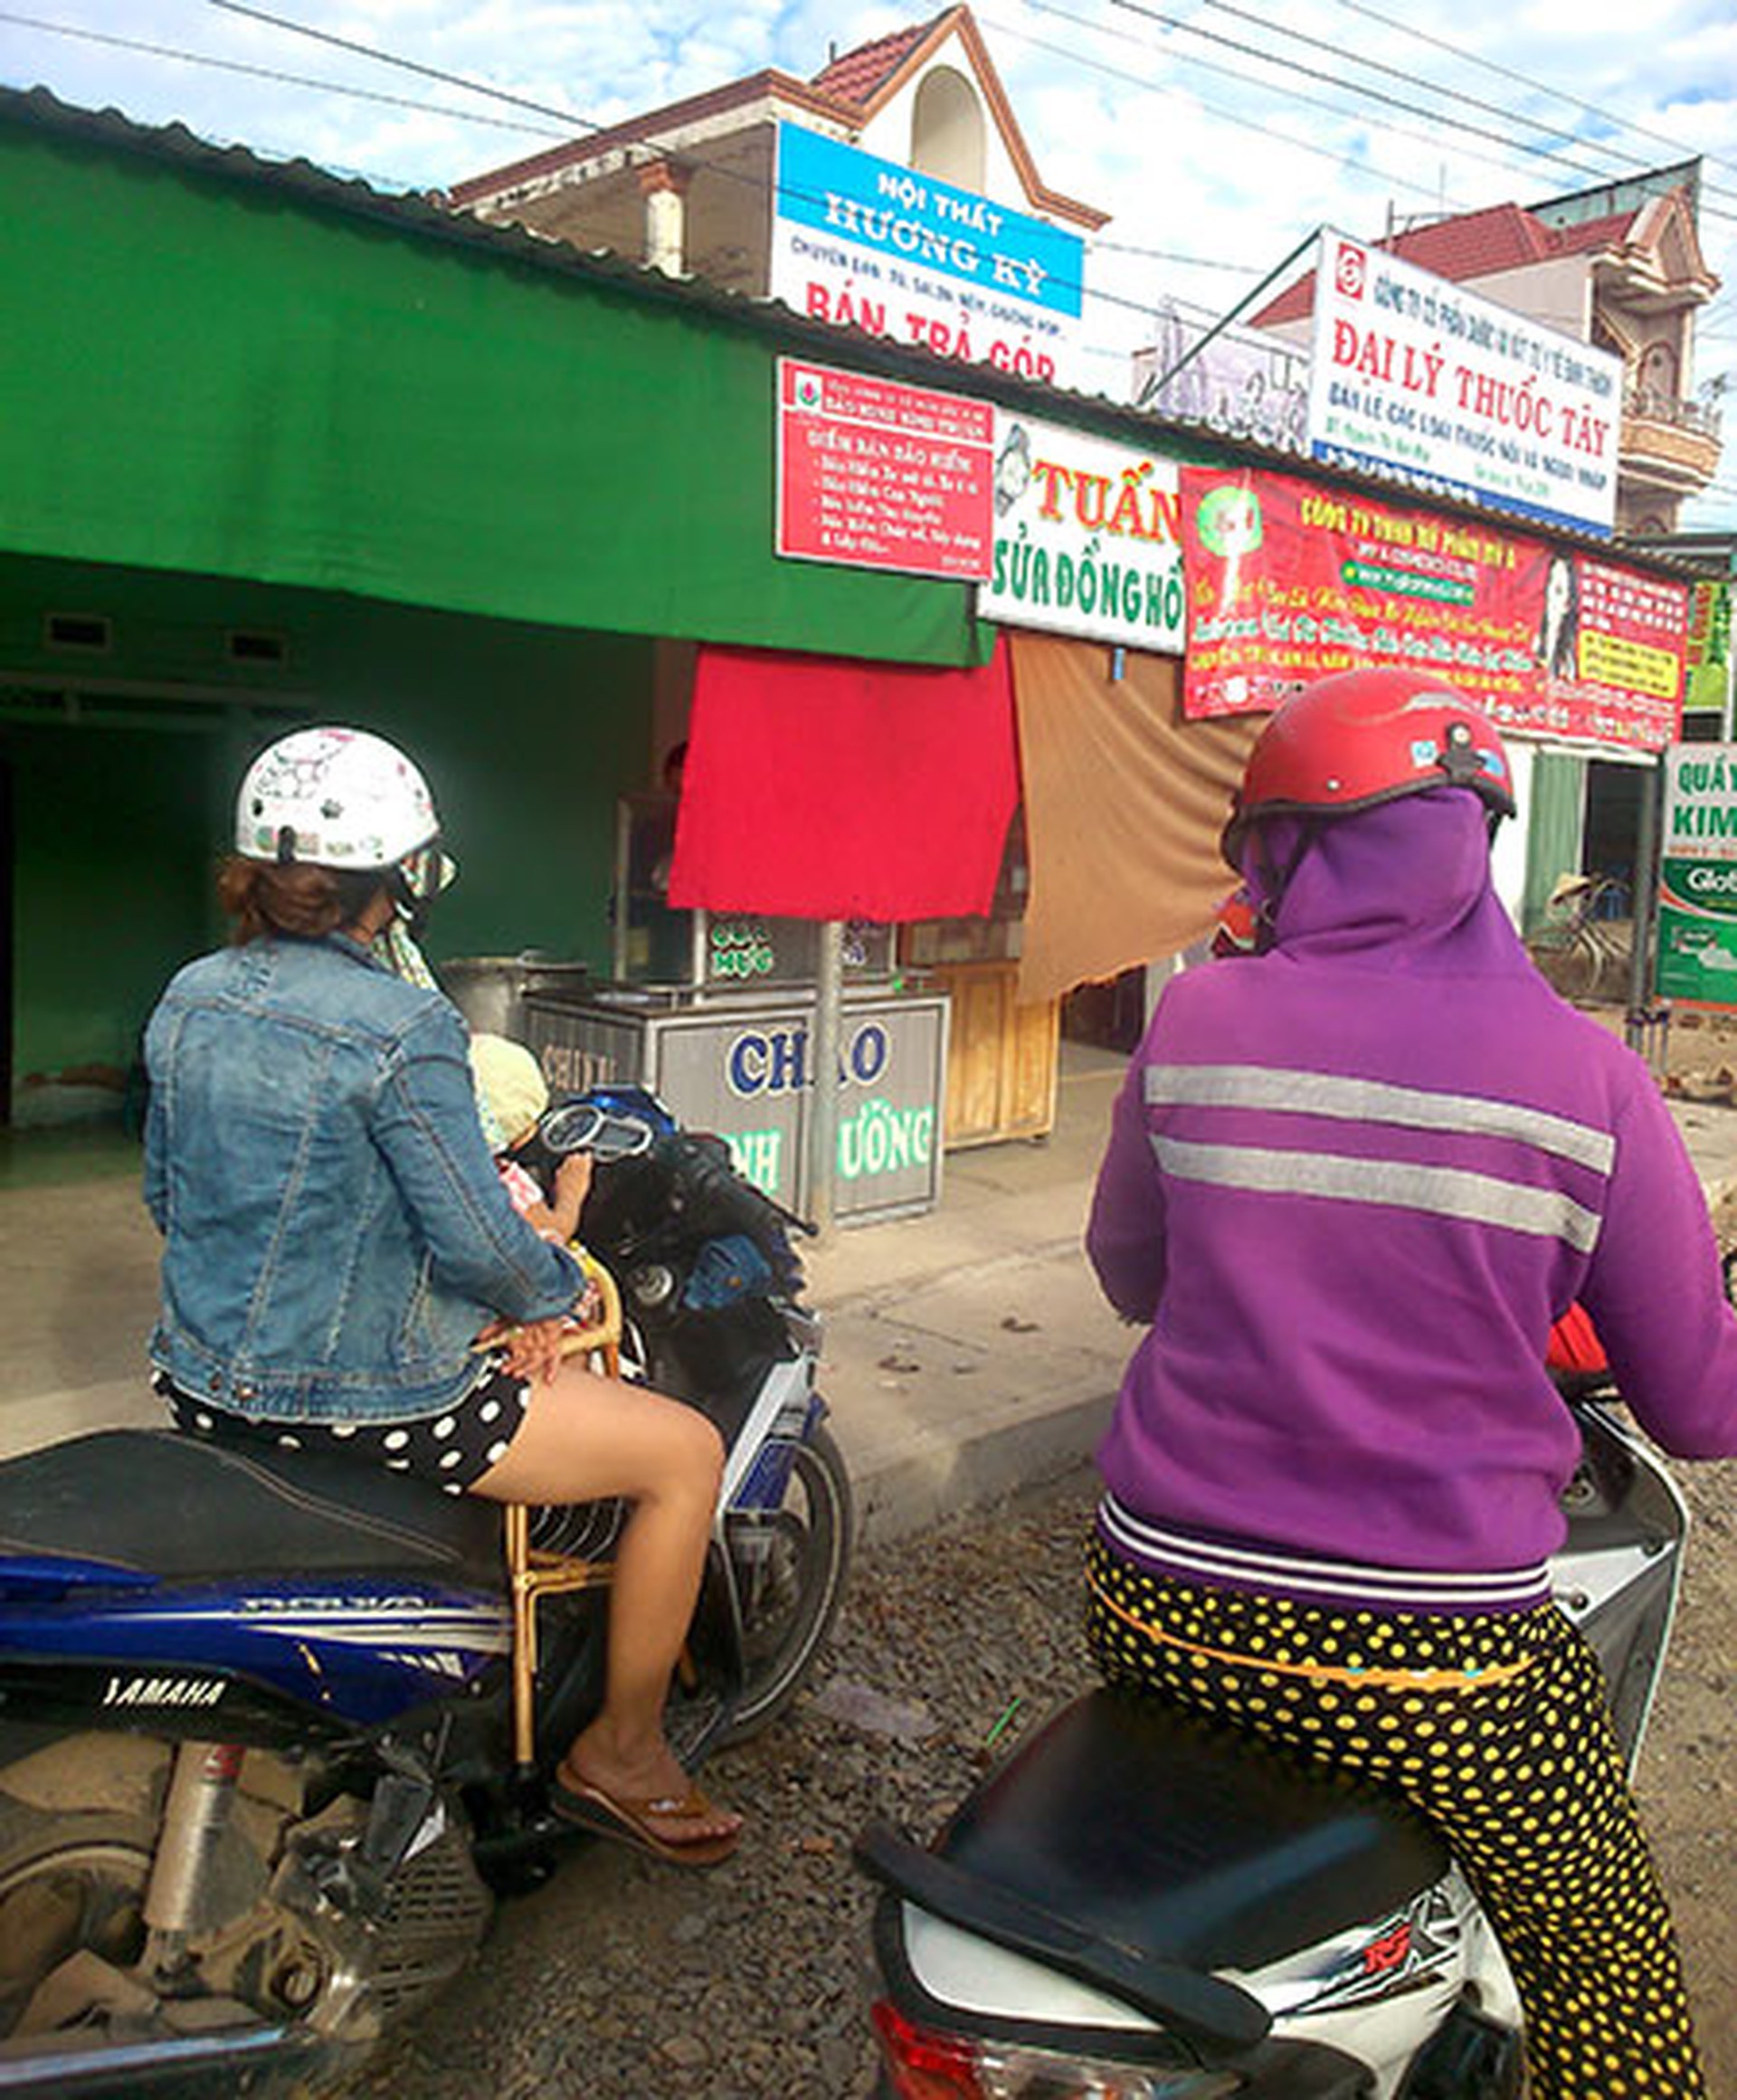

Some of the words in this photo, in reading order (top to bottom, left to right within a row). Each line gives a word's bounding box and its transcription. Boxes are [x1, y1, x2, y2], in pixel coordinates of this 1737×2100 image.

[824, 192, 981, 273] HƯƠNG
[878, 172, 926, 212] NỘI
[806, 279, 885, 335] BÁN
[906, 310, 971, 362] TRẢ
[1333, 318, 1395, 386] ĐẠI
[1403, 342, 1445, 397] LÝ
[1455, 365, 1553, 438] THUỐC
[1559, 404, 1610, 457] TÂY
[1032, 459, 1182, 547] TUẤN
[992, 520, 1050, 605] SỬA
[727, 1024, 888, 1098] CHO
[102, 1677, 227, 1706] YAMAHA
